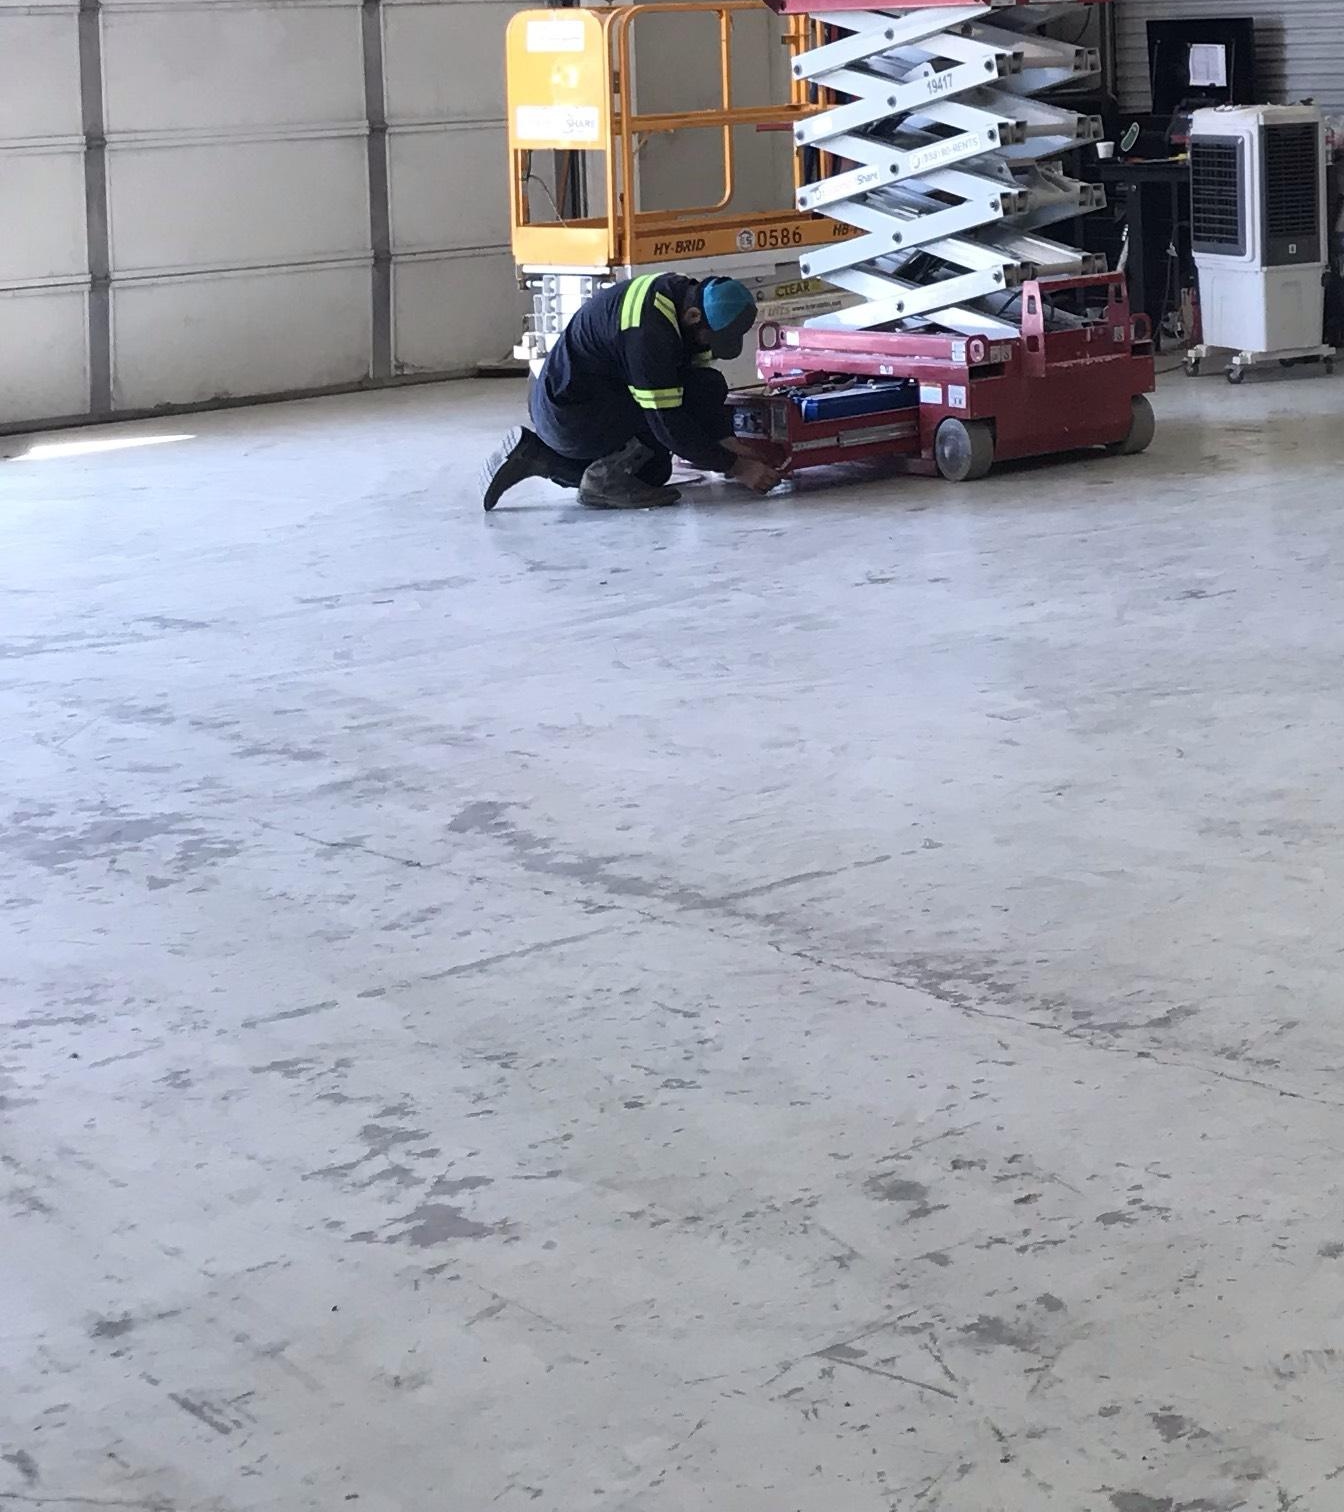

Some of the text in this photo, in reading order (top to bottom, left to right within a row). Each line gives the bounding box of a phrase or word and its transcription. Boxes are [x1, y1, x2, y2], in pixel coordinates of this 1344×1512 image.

[926, 74, 953, 95] 19417
[653, 239, 705, 255] HY-BRID
[757, 226, 802, 248] 0586
